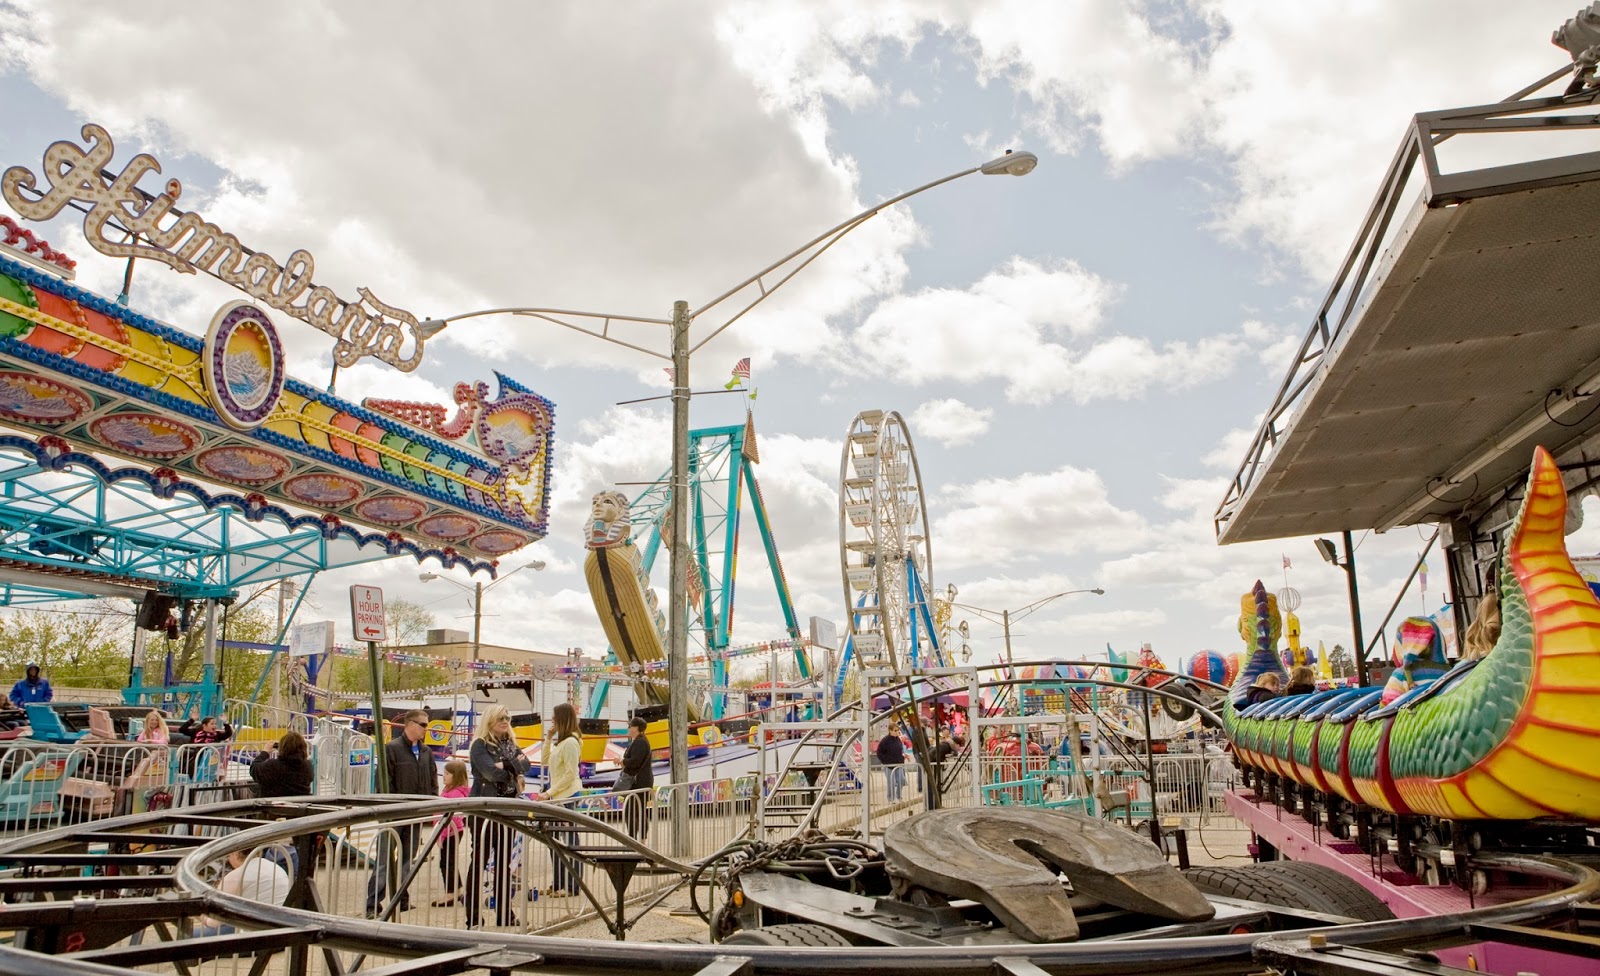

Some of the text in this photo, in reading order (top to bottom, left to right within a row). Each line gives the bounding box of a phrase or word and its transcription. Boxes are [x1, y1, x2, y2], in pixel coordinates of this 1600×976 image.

[1, 123, 425, 372] Himalaya
[358, 601, 380, 613] HOUR
[357, 613, 383, 626] PARKING
